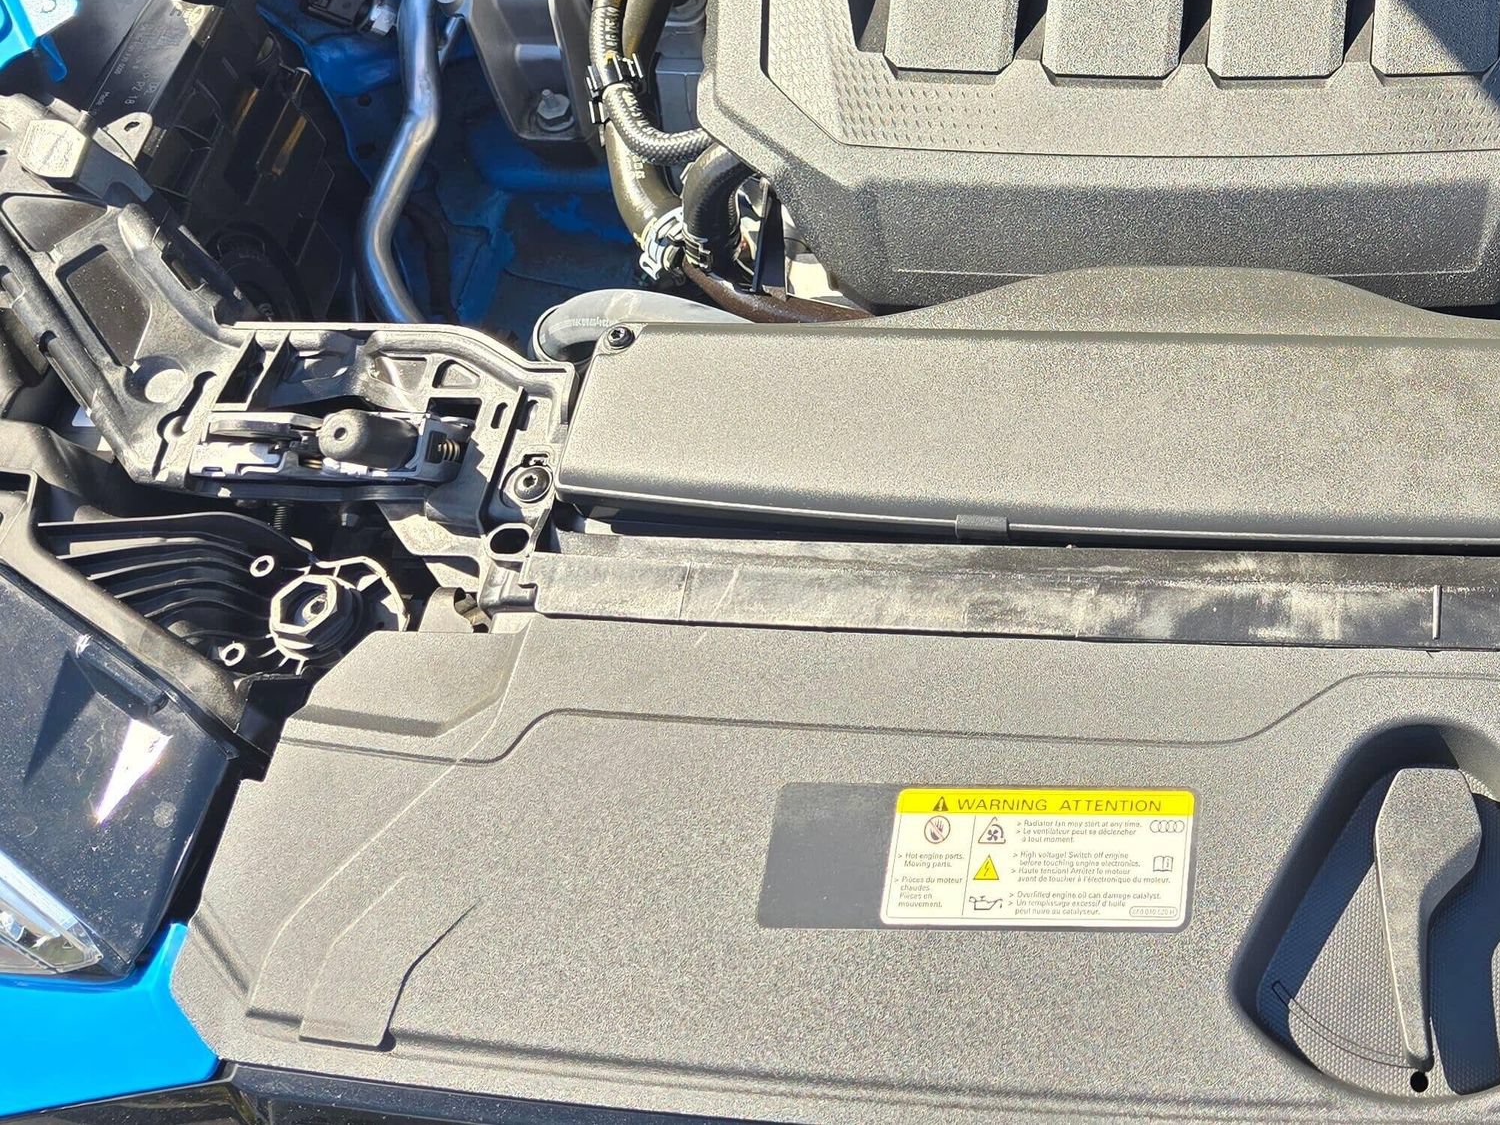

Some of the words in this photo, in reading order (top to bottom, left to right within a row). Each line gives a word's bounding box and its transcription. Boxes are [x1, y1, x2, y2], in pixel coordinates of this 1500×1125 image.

[957, 798, 1048, 811] WARNING
[1060, 799, 1163, 812] ATTENTION
[1023, 819, 1053, 827] Radiator
[919, 852, 943, 860] engine
[904, 860, 931, 868] Moving
[1044, 859, 1074, 868] touching
[1052, 891, 1076, 900] engine
